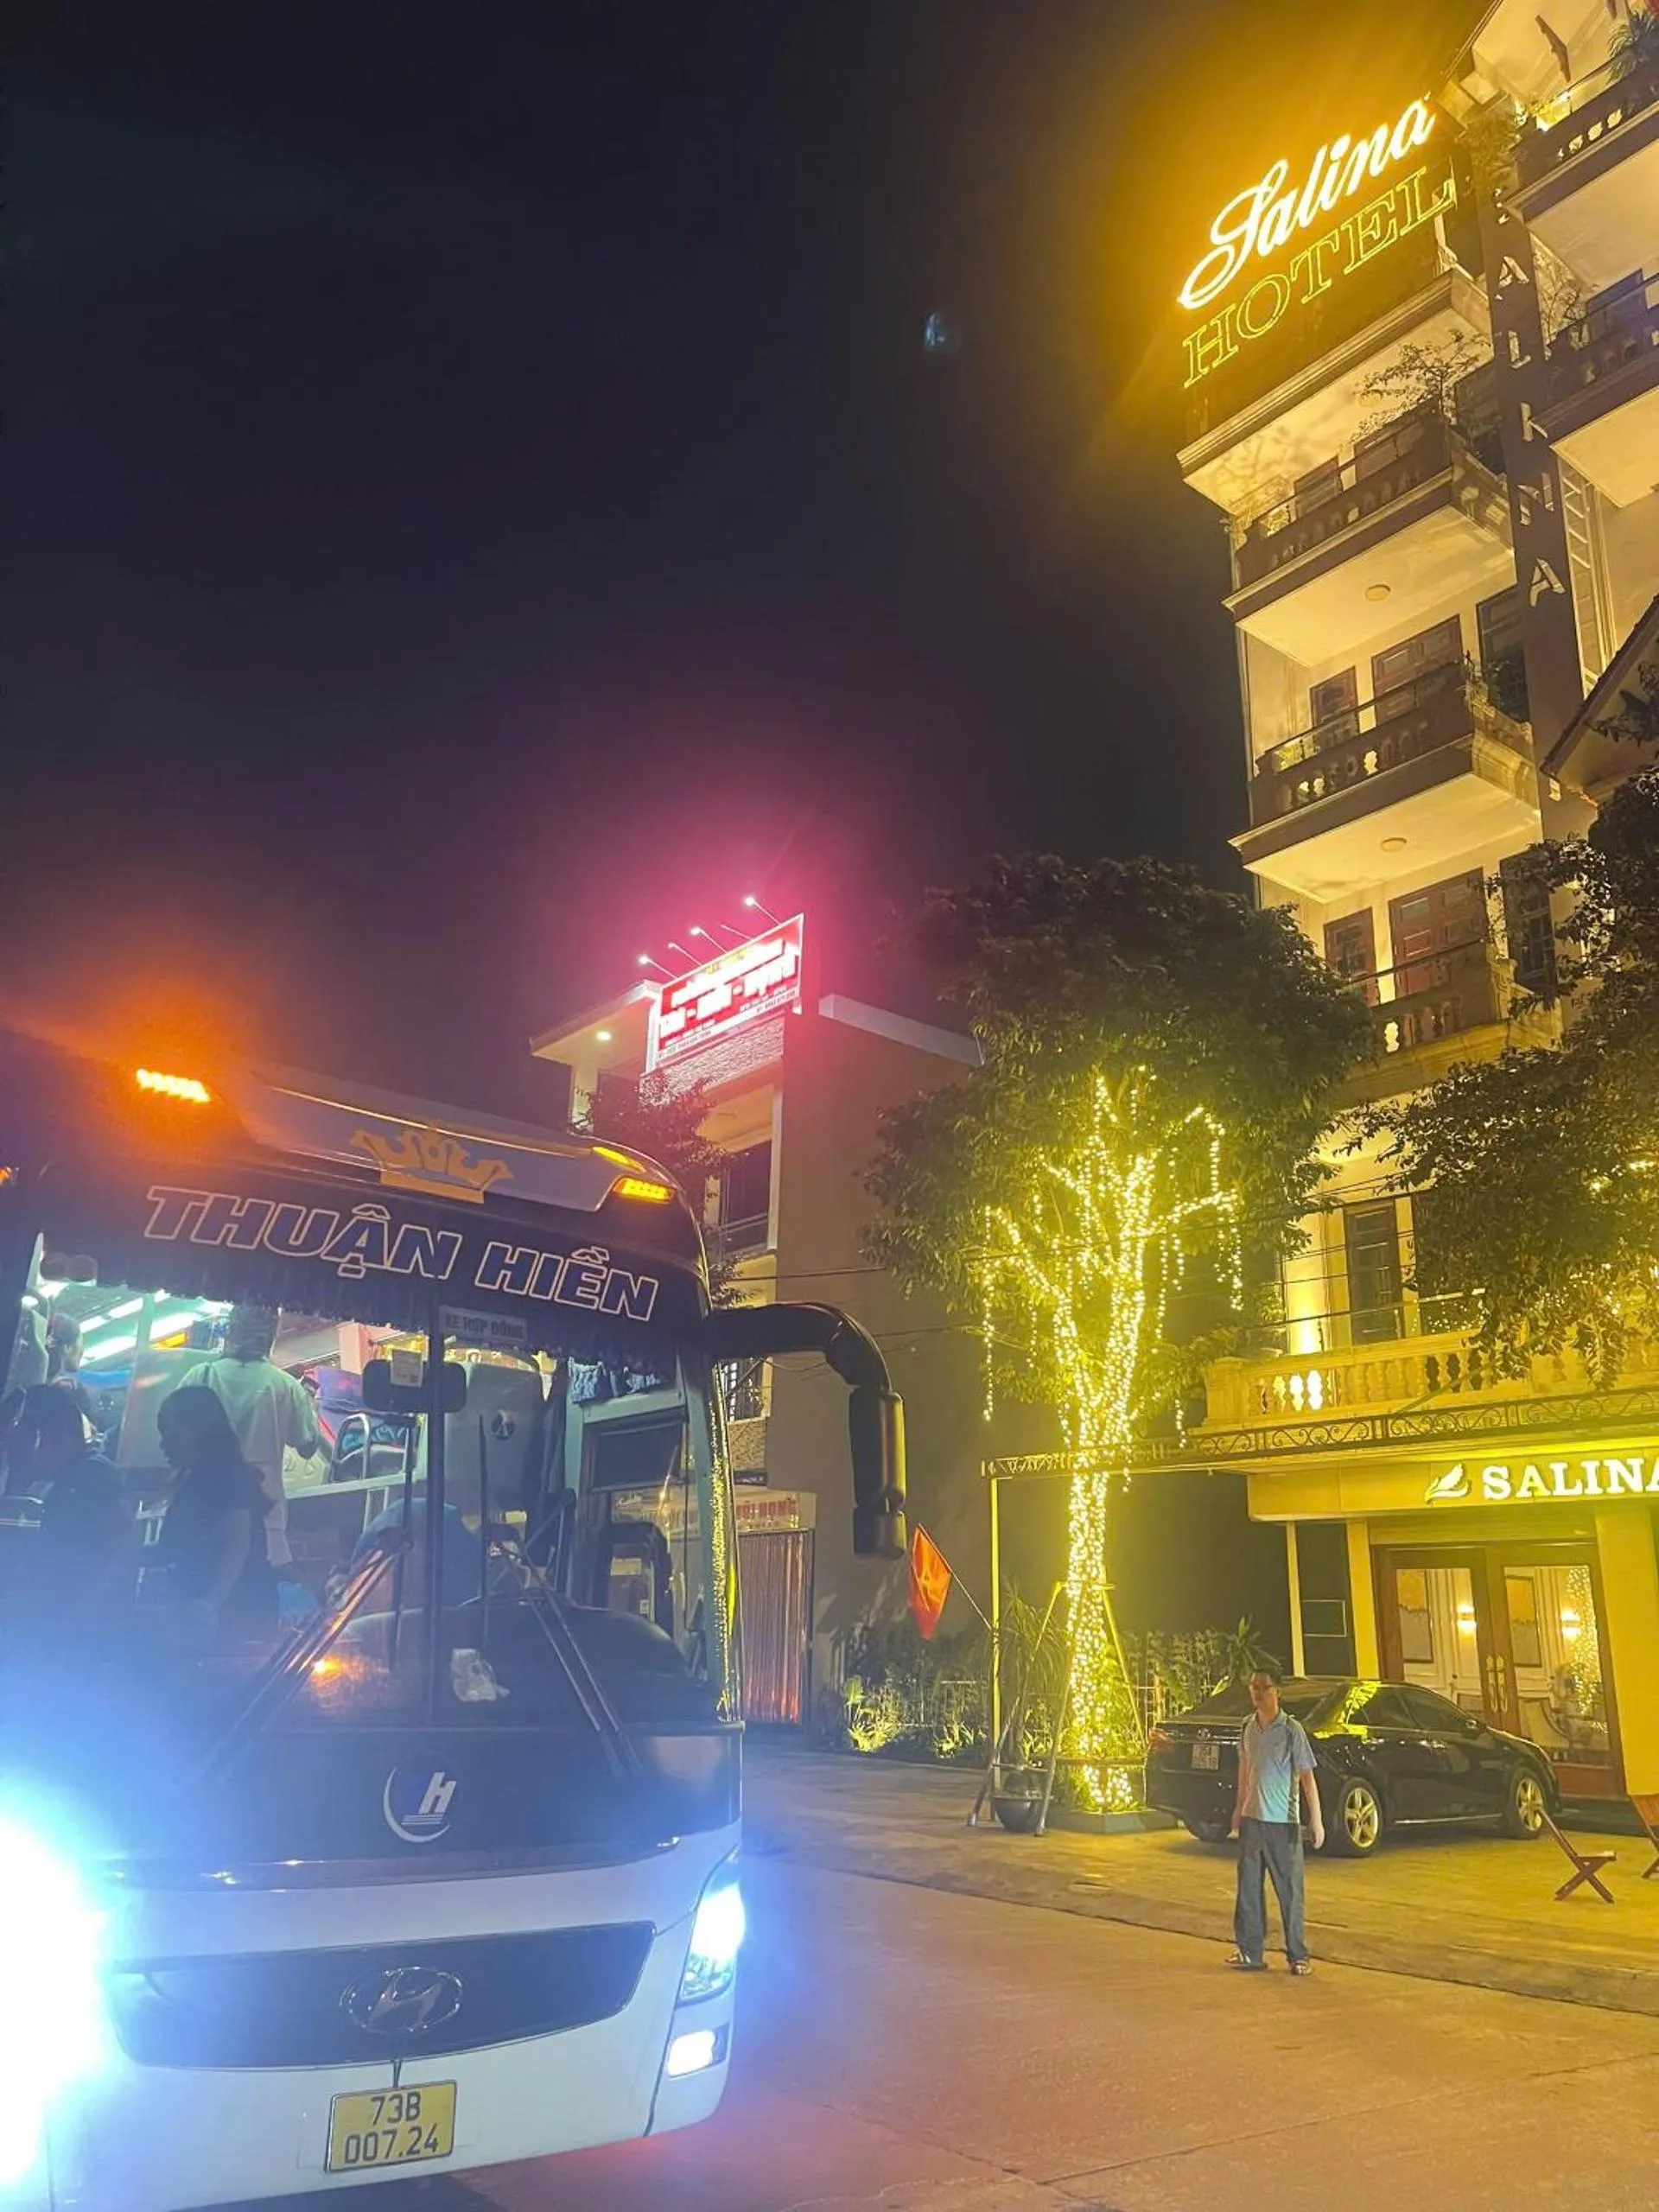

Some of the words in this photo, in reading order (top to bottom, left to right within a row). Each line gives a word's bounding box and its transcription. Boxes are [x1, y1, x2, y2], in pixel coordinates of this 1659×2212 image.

[1177, 91, 1439, 309] Salina
[1182, 165, 1457, 389] HOTEL
[144, 1185, 463, 1280] THUẬN
[345, 2123, 438, 2164] 007.24
[371, 2091, 421, 2126] 73B
